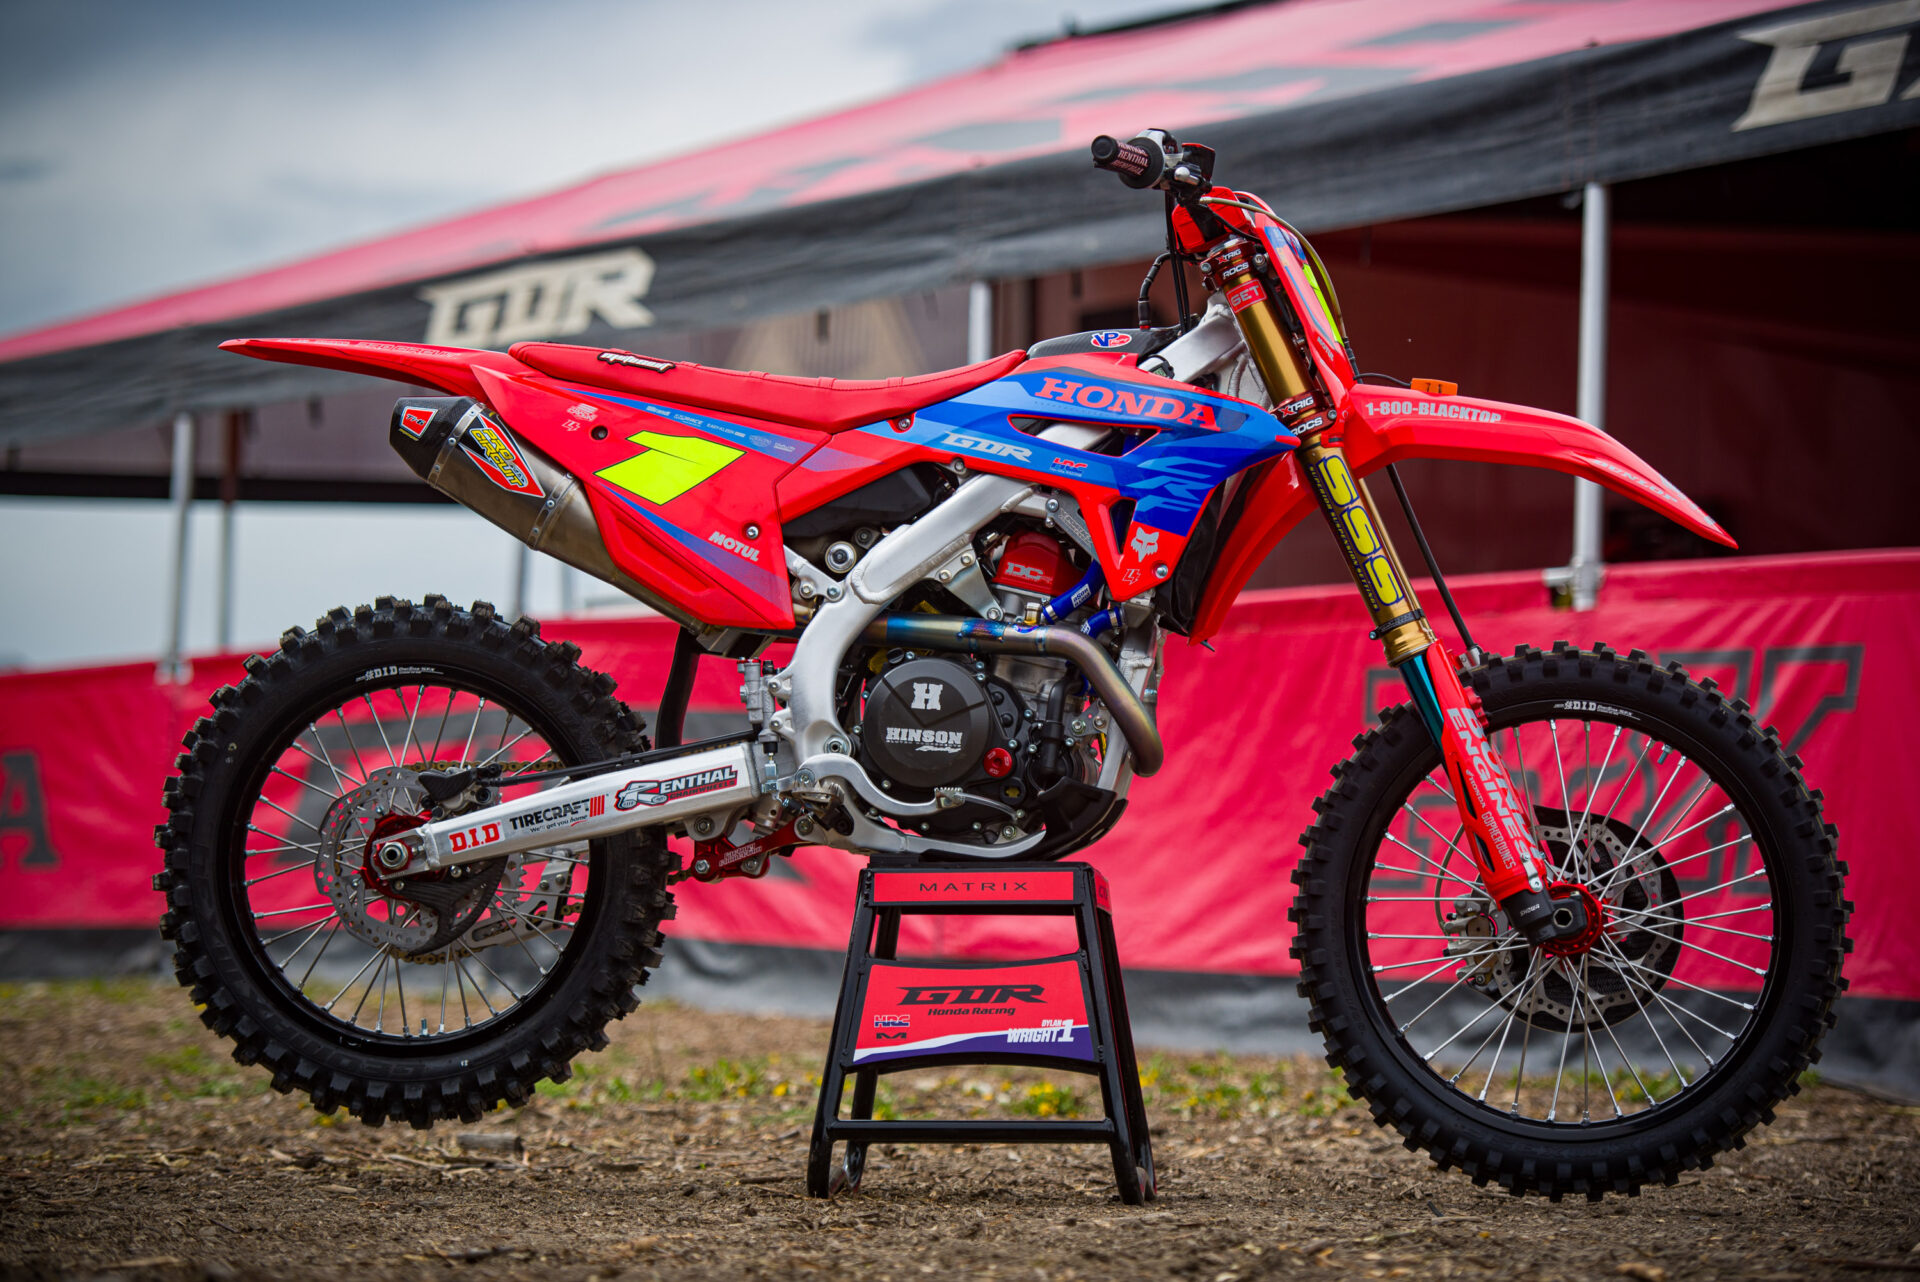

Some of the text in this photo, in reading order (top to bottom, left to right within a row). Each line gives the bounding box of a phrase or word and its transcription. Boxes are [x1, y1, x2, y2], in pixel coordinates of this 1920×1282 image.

[1117, 150, 1149, 168] RENTHAL
[1215, 248, 1242, 264] XTRIG
[1222, 262, 1249, 280] ROCS
[417, 246, 656, 350] GDR
[1093, 331, 1120, 347] VP
[1316, 335, 1335, 362] MOTUL
[1035, 377, 1221, 432] HONDA
[1278, 396, 1314, 418] XTRIG
[1365, 401, 1501, 423] 1-800-BLACKTOP
[1291, 417, 1323, 436] ROCS
[482, 429, 514, 461] PRO
[941, 431, 1032, 463] GDR
[471, 430, 523, 487] CIRCUIT
[1592, 459, 1678, 502] DUNLOP
[1309, 465, 1379, 611] SUPERIOR SUSPENSION SETTINGS
[1316, 455, 1404, 607] SSS
[708, 531, 760, 561] MOTUL
[1005, 562, 1043, 581] DC
[911, 682, 943, 711] H
[886, 727, 963, 744] HINSON
[1447, 708, 1530, 858] ENGINES
[1468, 775, 1486, 809] HONDA
[509, 799, 590, 830] TIRECRAFT
[546, 822, 557, 830] get
[557, 819, 569, 828] you
[449, 823, 500, 853] D.I.D
[919, 882, 1028, 892] MATRIX
[896, 984, 1048, 1006] GDR
[873, 1014, 910, 1028] HRC
[927, 1007, 1016, 1017] Honda Racing
[1041, 1019, 1062, 1027] DYLAN
[1007, 1019, 1075, 1043] WRIGHT 1
